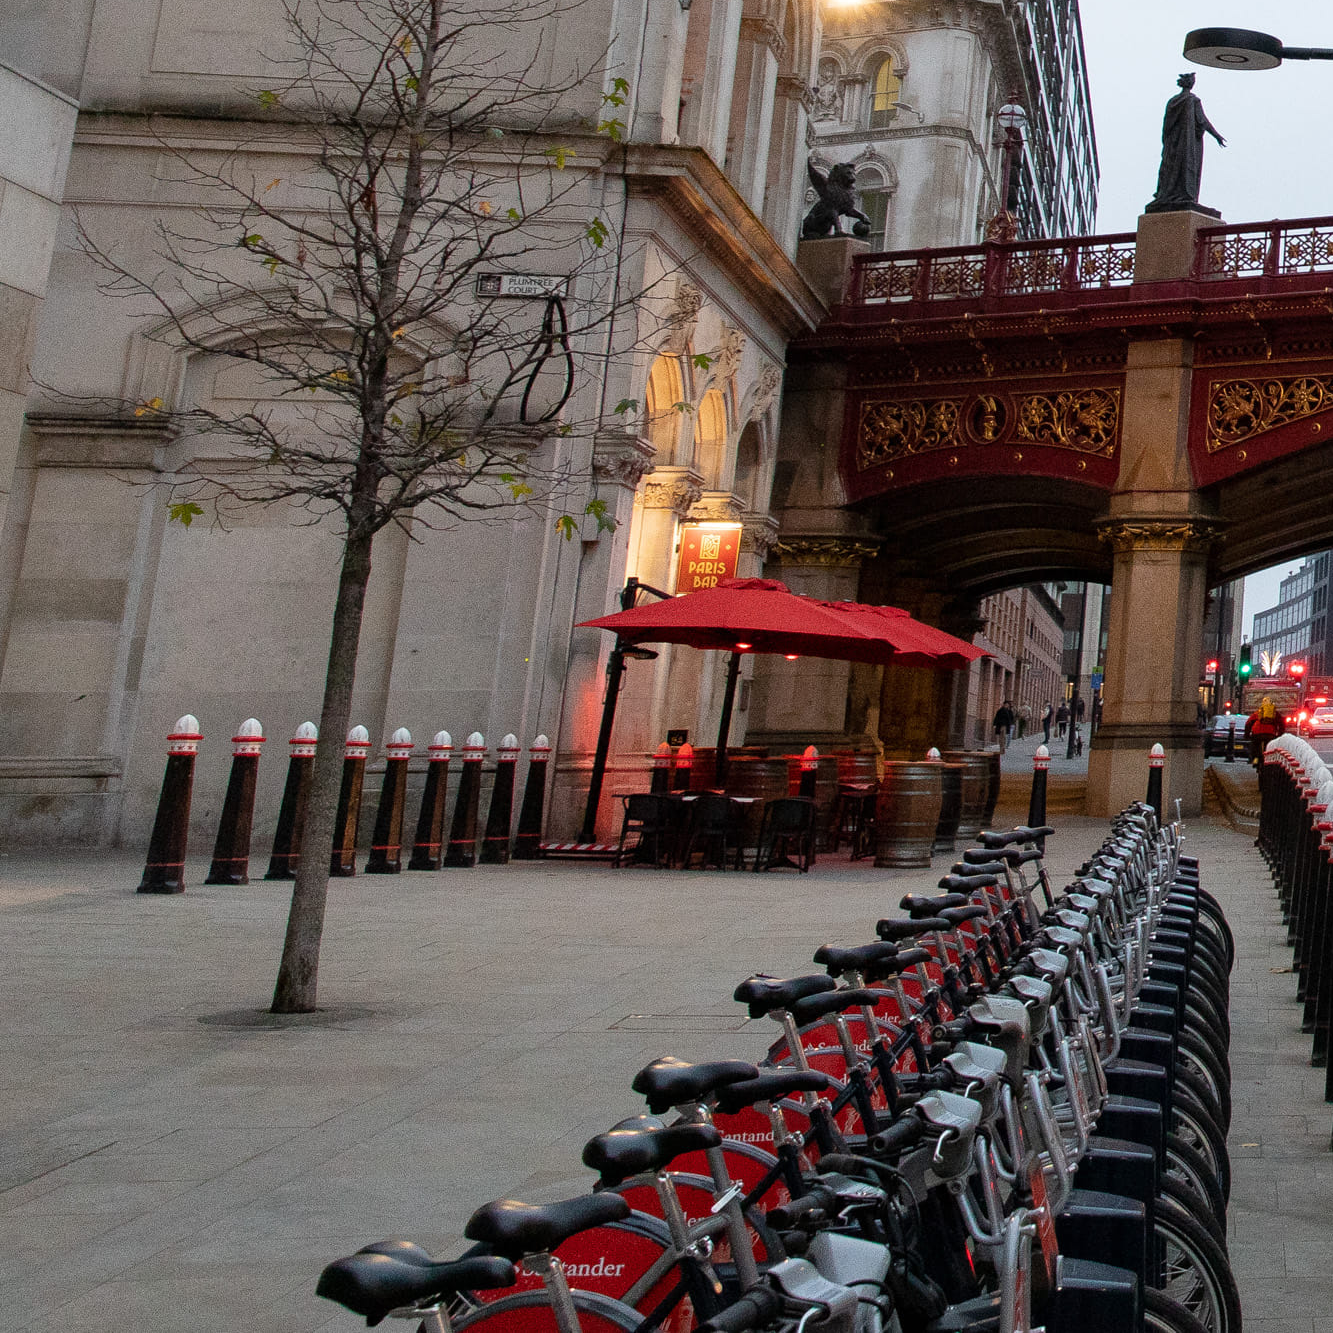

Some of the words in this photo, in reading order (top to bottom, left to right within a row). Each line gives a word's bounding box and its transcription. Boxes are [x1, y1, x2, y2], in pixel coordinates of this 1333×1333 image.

[508, 277, 554, 287] PLUMTREE
[507, 286, 538, 294] COURT
[688, 561, 726, 575] PARIS
[693, 575, 718, 588] BAR
